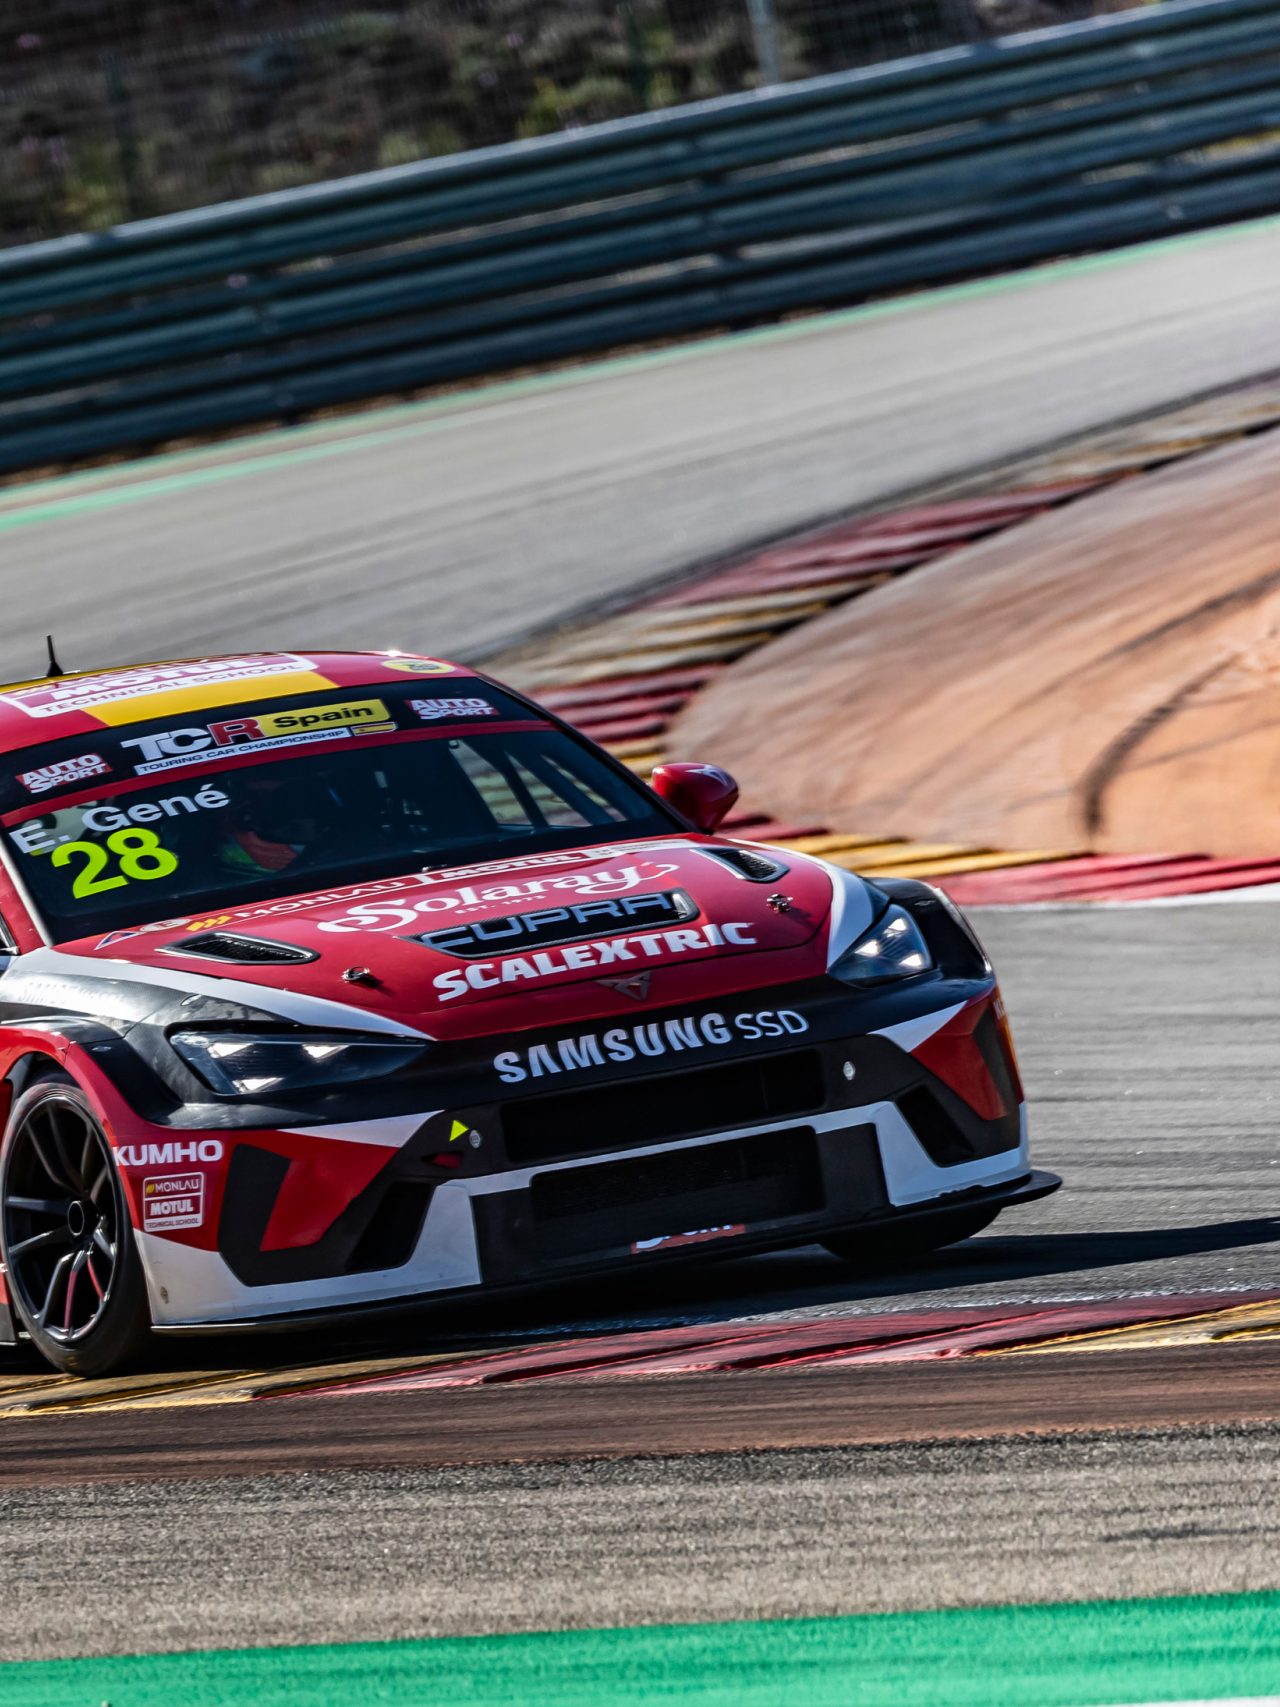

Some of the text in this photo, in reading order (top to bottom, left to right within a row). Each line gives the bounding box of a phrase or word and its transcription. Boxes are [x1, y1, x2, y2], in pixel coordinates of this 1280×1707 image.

[40, 679, 185, 713] TECHNICAL
[187, 664, 307, 685] SCHOOL
[51, 661, 269, 700] MOTUL
[410, 698, 489, 711] AUTO
[419, 707, 495, 720] SPORT
[121, 705, 375, 762] TCR Spain
[139, 729, 345, 773] TOURING CAR CHAMPIONSHIP
[23, 754, 103, 785] AUTO
[30, 763, 110, 794] SPORT
[8, 783, 231, 854] E. Gené
[51, 827, 179, 900] 28
[235, 853, 583, 919] MONLAU MOTUL
[317, 861, 680, 933] Solaray
[420, 892, 675, 950] CUPRA
[432, 922, 757, 1002] SCALEXTRIC
[493, 1009, 810, 1083] SAMSUNG SSD
[112, 1139, 223, 1167] KUMHO
[150, 1199, 194, 1216] MOTUL
[155, 1179, 200, 1193] MONLAU
[175, 1217, 199, 1226] SCHOOL
